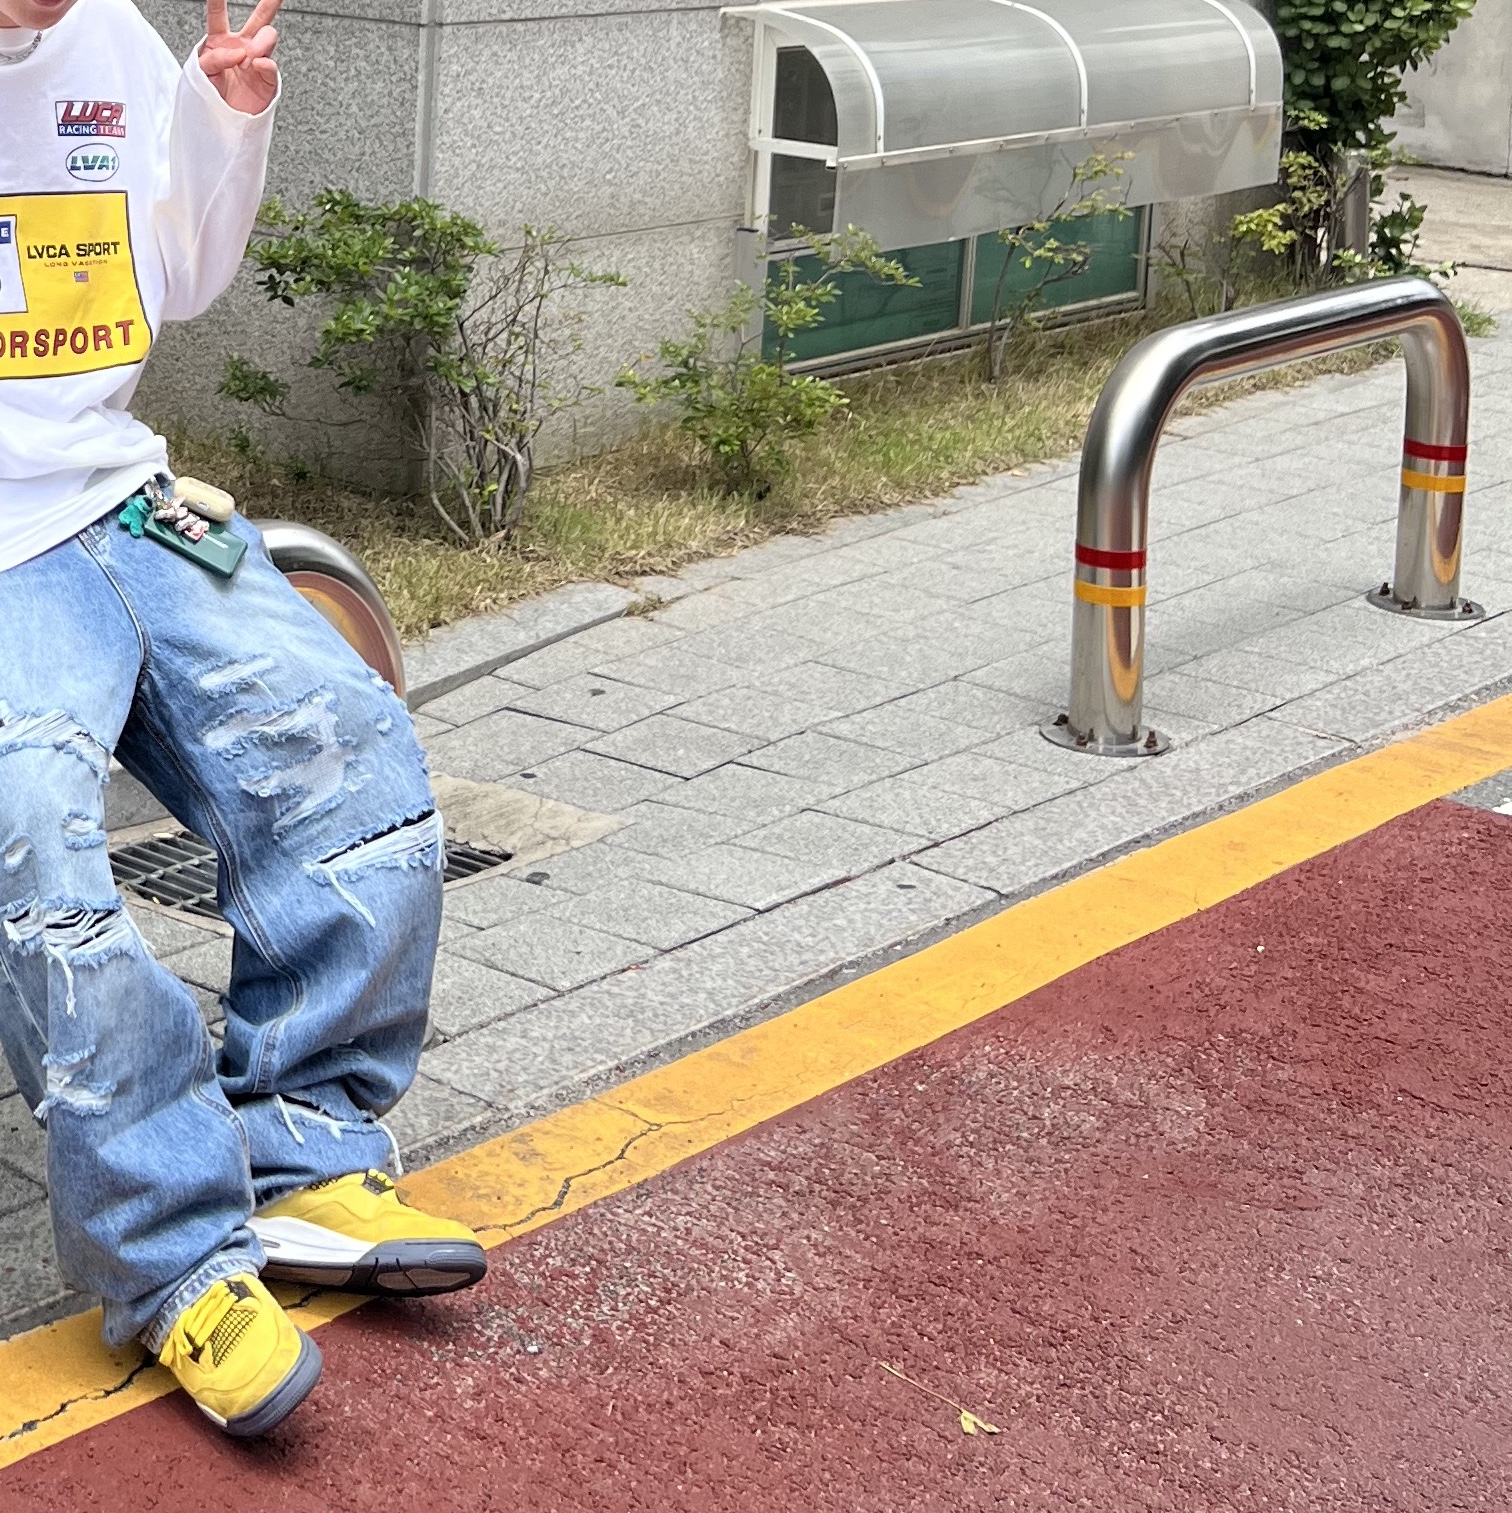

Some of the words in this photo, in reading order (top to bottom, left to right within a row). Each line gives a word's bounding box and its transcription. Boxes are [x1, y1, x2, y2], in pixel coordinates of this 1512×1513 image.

[61, 101, 124, 124] LUCA
[59, 124, 98, 135] RACING
[99, 125, 125, 136] TEAM
[26, 244, 71, 259] LVCA
[75, 241, 121, 257] SPORT
